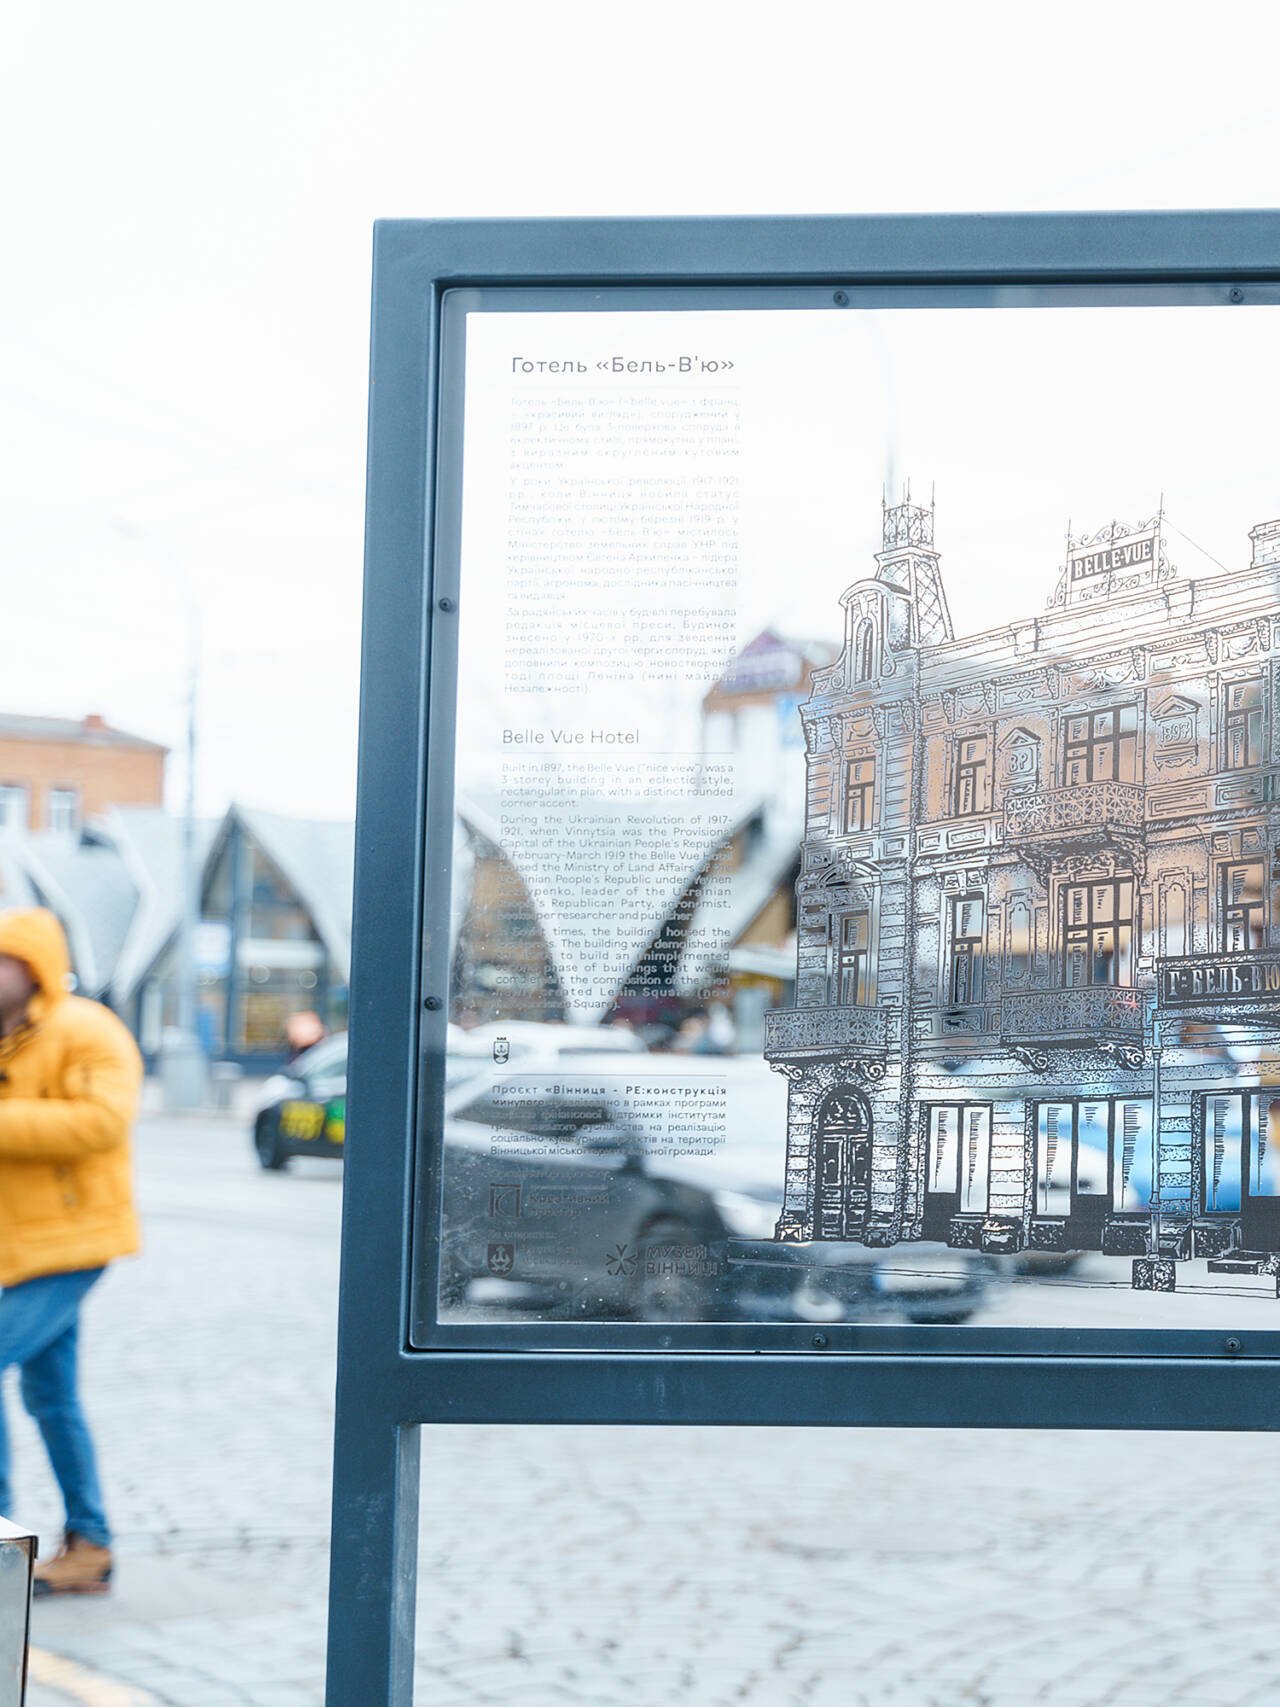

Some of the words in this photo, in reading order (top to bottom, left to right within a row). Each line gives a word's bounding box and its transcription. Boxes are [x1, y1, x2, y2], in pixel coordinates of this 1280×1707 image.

[511, 356, 588, 373] Готель
[596, 356, 735, 373] «Бель-В'ю»
[1074, 541, 1152, 579] BELLE-VUE
[504, 729, 545, 744] Belle
[550, 729, 585, 744] Vue
[591, 728, 639, 744] Hotel
[502, 763, 527, 772] Built
[528, 763, 538, 772] in
[567, 763, 585, 772] the
[587, 763, 612, 772] Belle
[614, 763, 635, 772] Vue
[558, 775, 605, 786] building
[611, 775, 622, 784] in
[648, 775, 696, 784] eclectic
[702, 775, 734, 786] style,
[501, 787, 566, 798] rectangular
[567, 787, 577, 796] in
[580, 787, 606, 798] plan,
[609, 787, 632, 796] with
[643, 787, 684, 796] distinct
[687, 787, 734, 796] rounded
[539, 798, 579, 807] accent.
[500, 815, 538, 826] During
[544, 815, 562, 824] the
[569, 815, 621, 824] Ukrainian
[627, 815, 684, 824] Revolution
[690, 815, 703, 824] of
[708, 815, 733, 824] 1917-
[500, 827, 523, 838] 1921,
[530, 827, 559, 836] when
[565, 827, 616, 838] Vinnytsia
[648, 827, 667, 836] the
[499, 839, 538, 850] Capital
[543, 839, 555, 848] of
[557, 839, 575, 848] the
[579, 839, 631, 848] Ukrainian
[635, 839, 680, 850] People's
[512, 851, 601, 862] February-March
[604, 851, 625, 860] 1919
[629, 851, 647, 860] the
[650, 851, 676, 860] Belle
[679, 851, 700, 860] Vue
[543, 863, 560, 872] the
[565, 863, 609, 874] Ministry
[614, 863, 625, 872] of
[628, 863, 654, 872] Land
[658, 863, 695, 872] Affairs
[555, 875, 600, 886] People's
[604, 875, 651, 886] Republic
[655, 875, 689, 884] under
[581, 887, 619, 896] leader
[626, 887, 639, 896] of
[645, 887, 665, 896] the
[552, 899, 614, 910] Republican
[620, 899, 655, 910] Party,
[557, 911, 617, 920] researcher
[618, 911, 639, 920] and
[553, 927, 586, 939] times,
[592, 927, 610, 936] the
[617, 927, 660, 939] building
[712, 927, 731, 936] the
[561, 939, 581, 948] The
[584, 939, 628, 950] building
[654, 939, 717, 948] demolished
[561, 951, 573, 960] to
[580, 951, 609, 960] build
[584, 963, 597, 972] of
[570, 975, 588, 984] the
[592, 975, 661, 986] composition
[681, 975, 699, 984] the
[545, 1085, 606, 1097] «Вінниця
[626, 1085, 727, 1097] РЕ:конструкція
[633, 1100, 671, 1109] рамках
[674, 1100, 727, 1109] програми
[668, 1110, 726, 1121] інститутам
[667, 1122, 726, 1134] реалізацію
[678, 1134, 726, 1145] території
[490, 1146, 548, 1157] Вінницької
[668, 1148, 717, 1157] громади.
[646, 1244, 707, 1258] МУЗЕЙ
